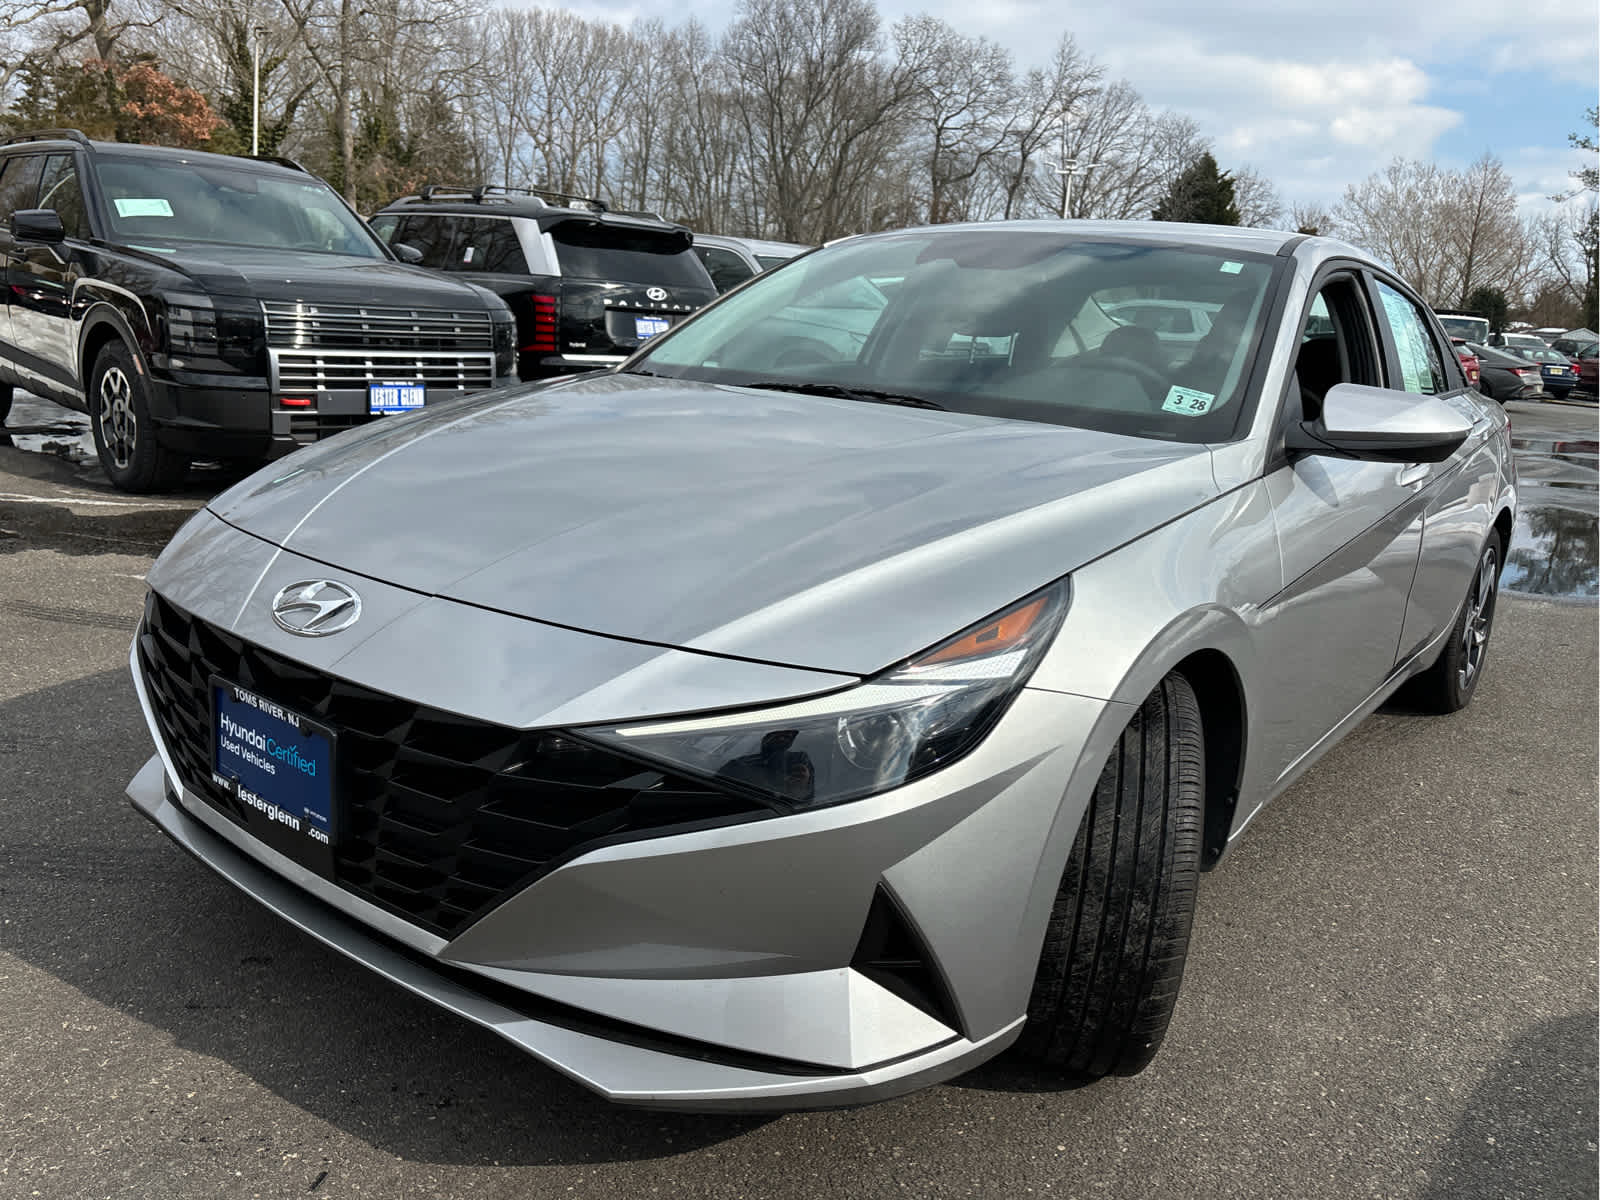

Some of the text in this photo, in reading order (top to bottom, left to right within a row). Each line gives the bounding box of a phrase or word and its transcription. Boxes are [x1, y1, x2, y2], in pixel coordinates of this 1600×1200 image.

[1174, 394, 1184, 405] 3
[1189, 398, 1207, 411] 28
[235, 687, 257, 708] TOMS
[288, 712, 299, 728] NJ
[220, 711, 316, 776] Hyundai Certified
[220, 736, 276, 775] Used Vehicles
[238, 784, 300, 831] lesterglenn
[308, 827, 329, 845] .com
